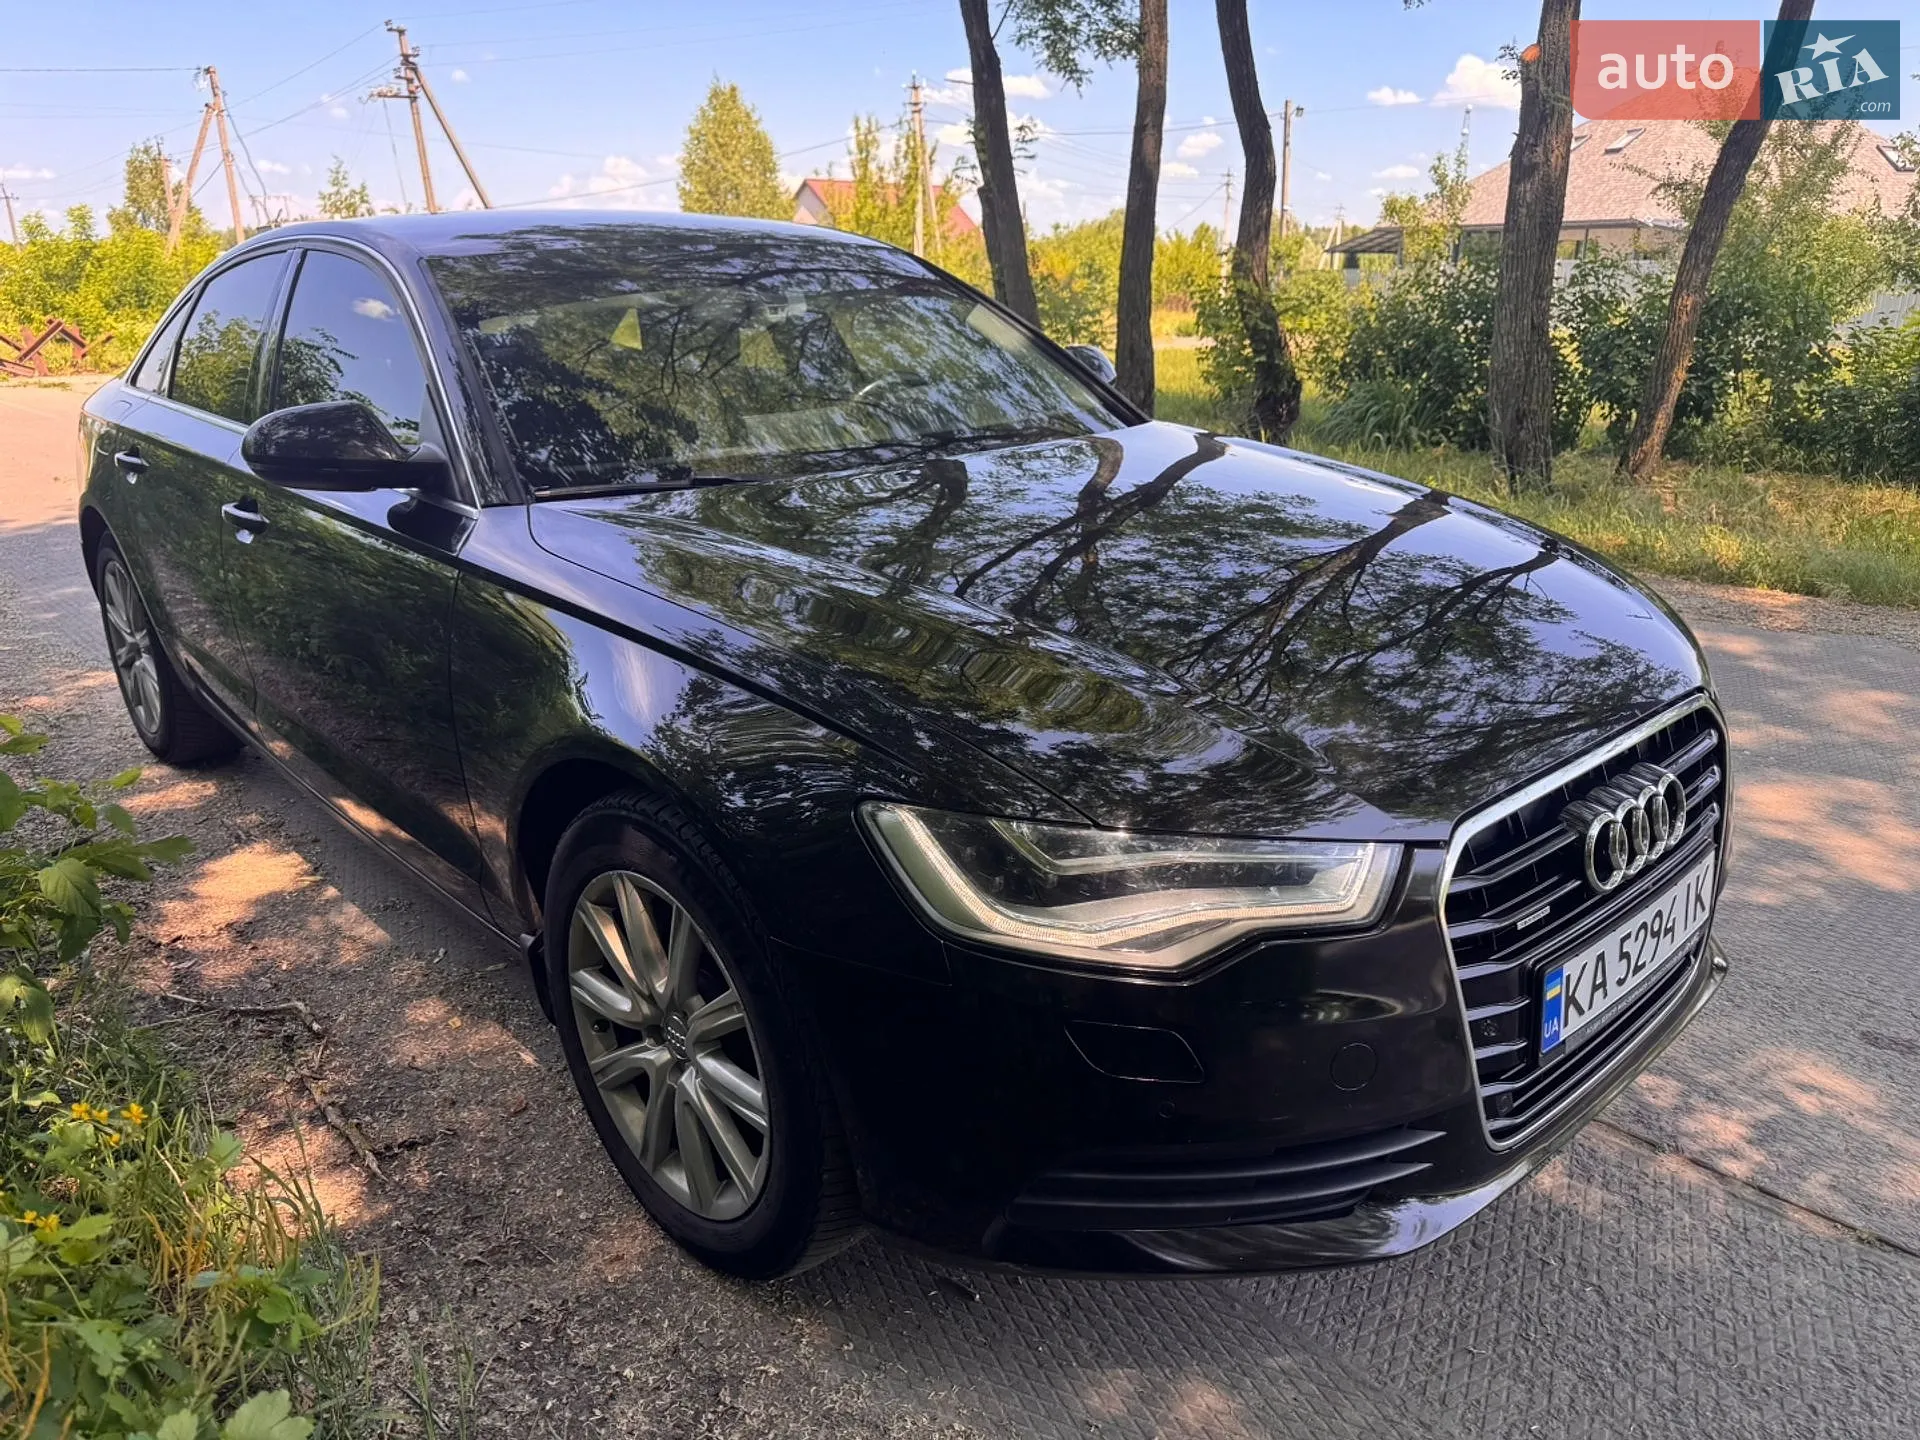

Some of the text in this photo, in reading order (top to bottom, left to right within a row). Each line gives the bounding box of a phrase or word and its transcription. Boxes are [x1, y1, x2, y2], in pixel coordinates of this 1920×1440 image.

[1563, 863, 1709, 1029] KA 5294 IK
[1544, 1017, 1559, 1038] UA
